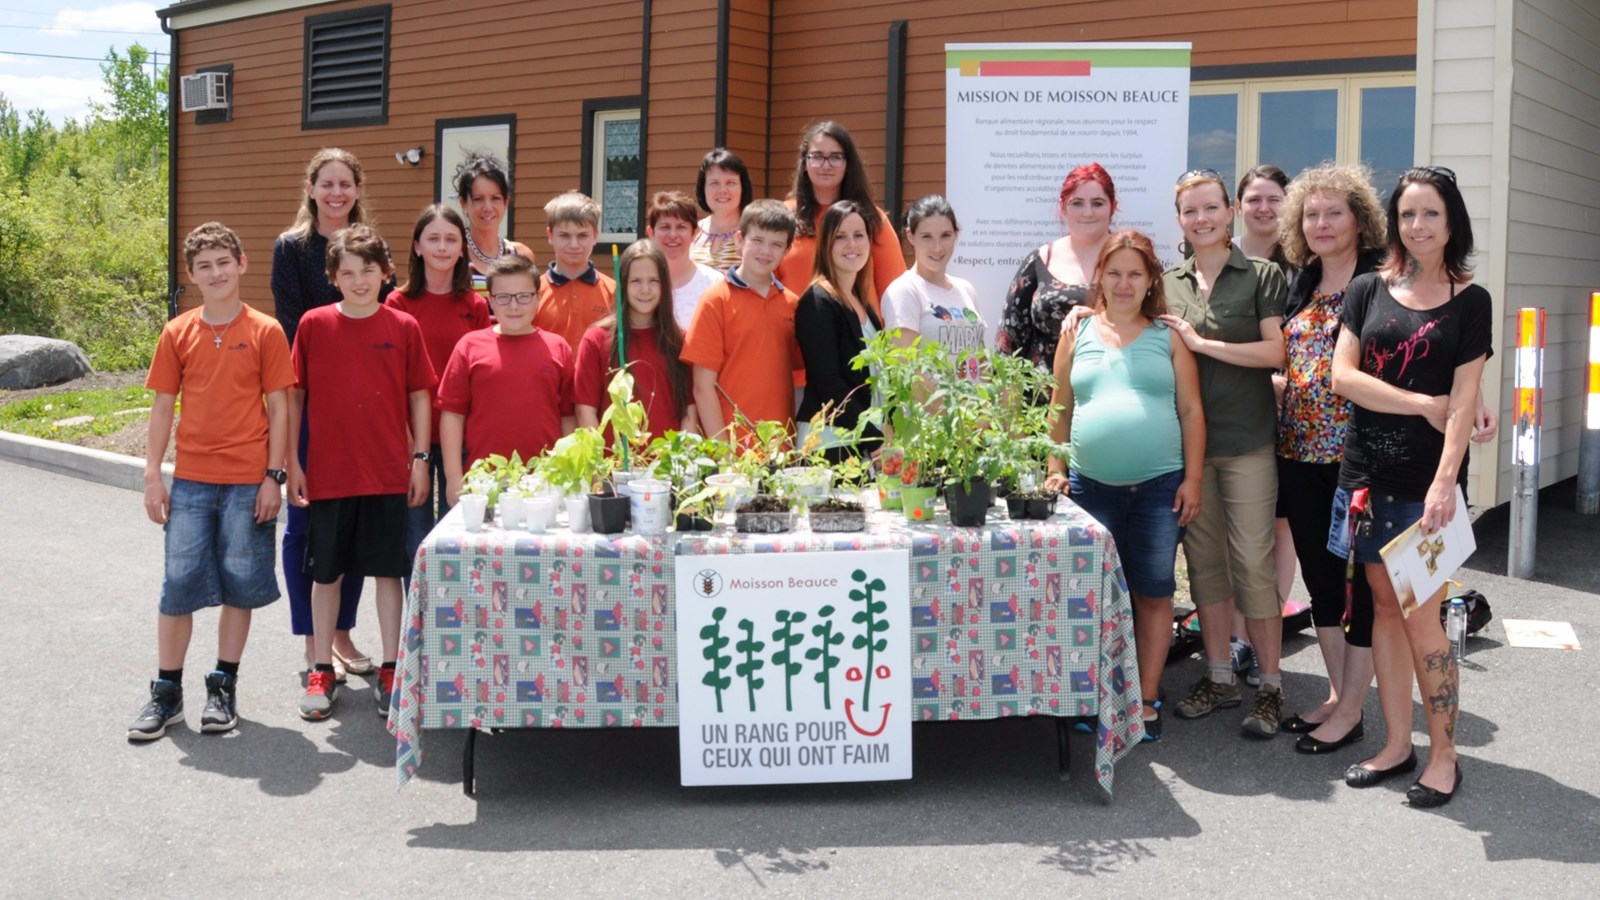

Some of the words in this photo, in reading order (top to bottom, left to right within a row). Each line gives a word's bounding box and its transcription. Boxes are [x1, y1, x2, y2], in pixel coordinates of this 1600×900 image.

[957, 90, 1018, 102] MISSION
[1024, 90, 1042, 102] DE
[1048, 90, 1117, 102] MOISSON
[1122, 90, 1179, 102] BEAUCE
[729, 578, 784, 590] Moisson
[788, 577, 838, 588] Beauce
[702, 724, 728, 744] UN
[735, 722, 789, 744] RANG
[796, 720, 848, 742] POUR
[702, 747, 752, 768] CEUX
[759, 746, 791, 768] QUI
[798, 745, 837, 766] ONT
[843, 743, 890, 764] FAIM
